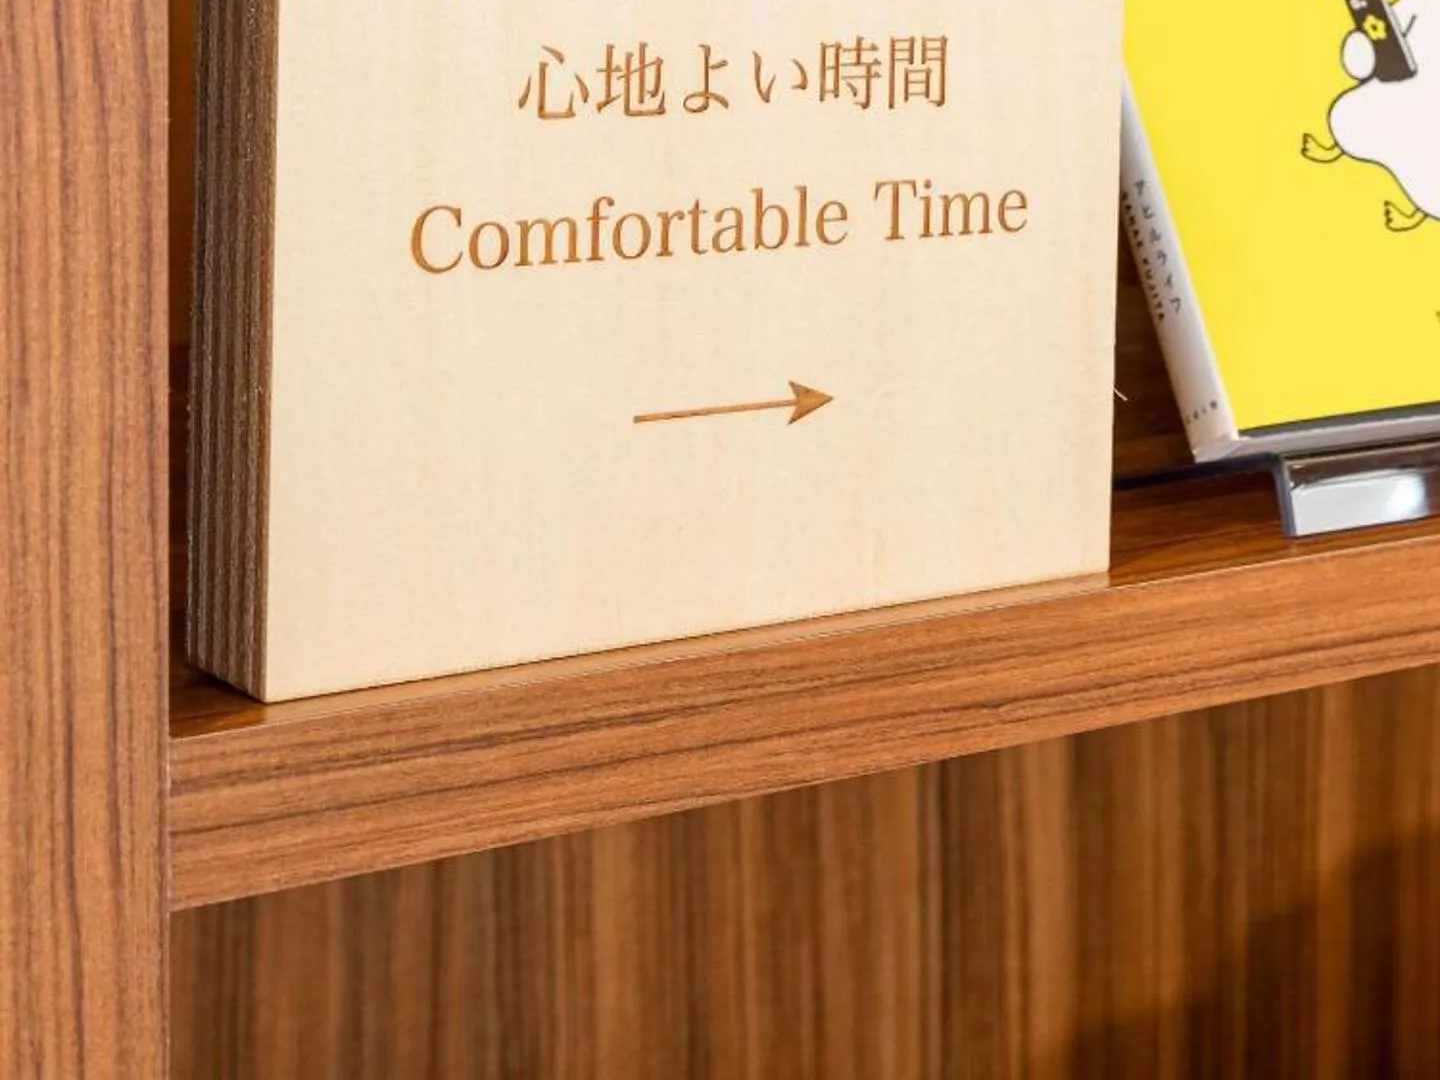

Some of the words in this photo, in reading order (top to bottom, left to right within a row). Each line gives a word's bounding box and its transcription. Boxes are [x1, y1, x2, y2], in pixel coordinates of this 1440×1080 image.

[516, 34, 950, 120] 心地よい時間
[409, 185, 850, 275] Comfortable
[873, 178, 1029, 242] Time
